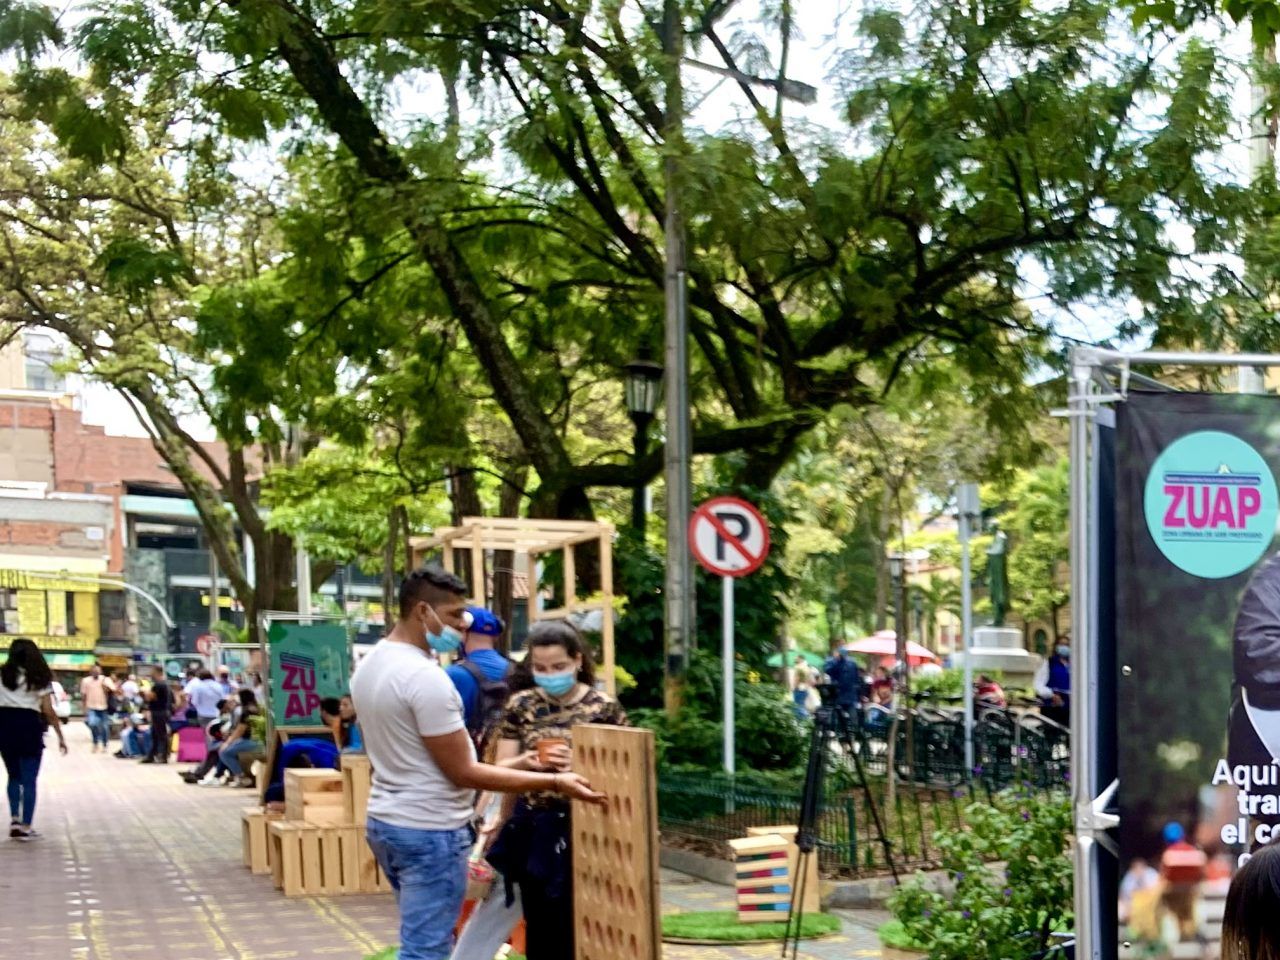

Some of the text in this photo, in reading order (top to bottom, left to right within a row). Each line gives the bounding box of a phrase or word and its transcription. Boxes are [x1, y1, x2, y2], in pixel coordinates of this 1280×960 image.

[1164, 485, 1261, 529] ZUAP
[716, 512, 750, 561] P
[281, 663, 316, 691] ZU
[285, 692, 320, 719] AP
[1211, 758, 1278, 791] Aquí
[1220, 818, 1246, 844] el
